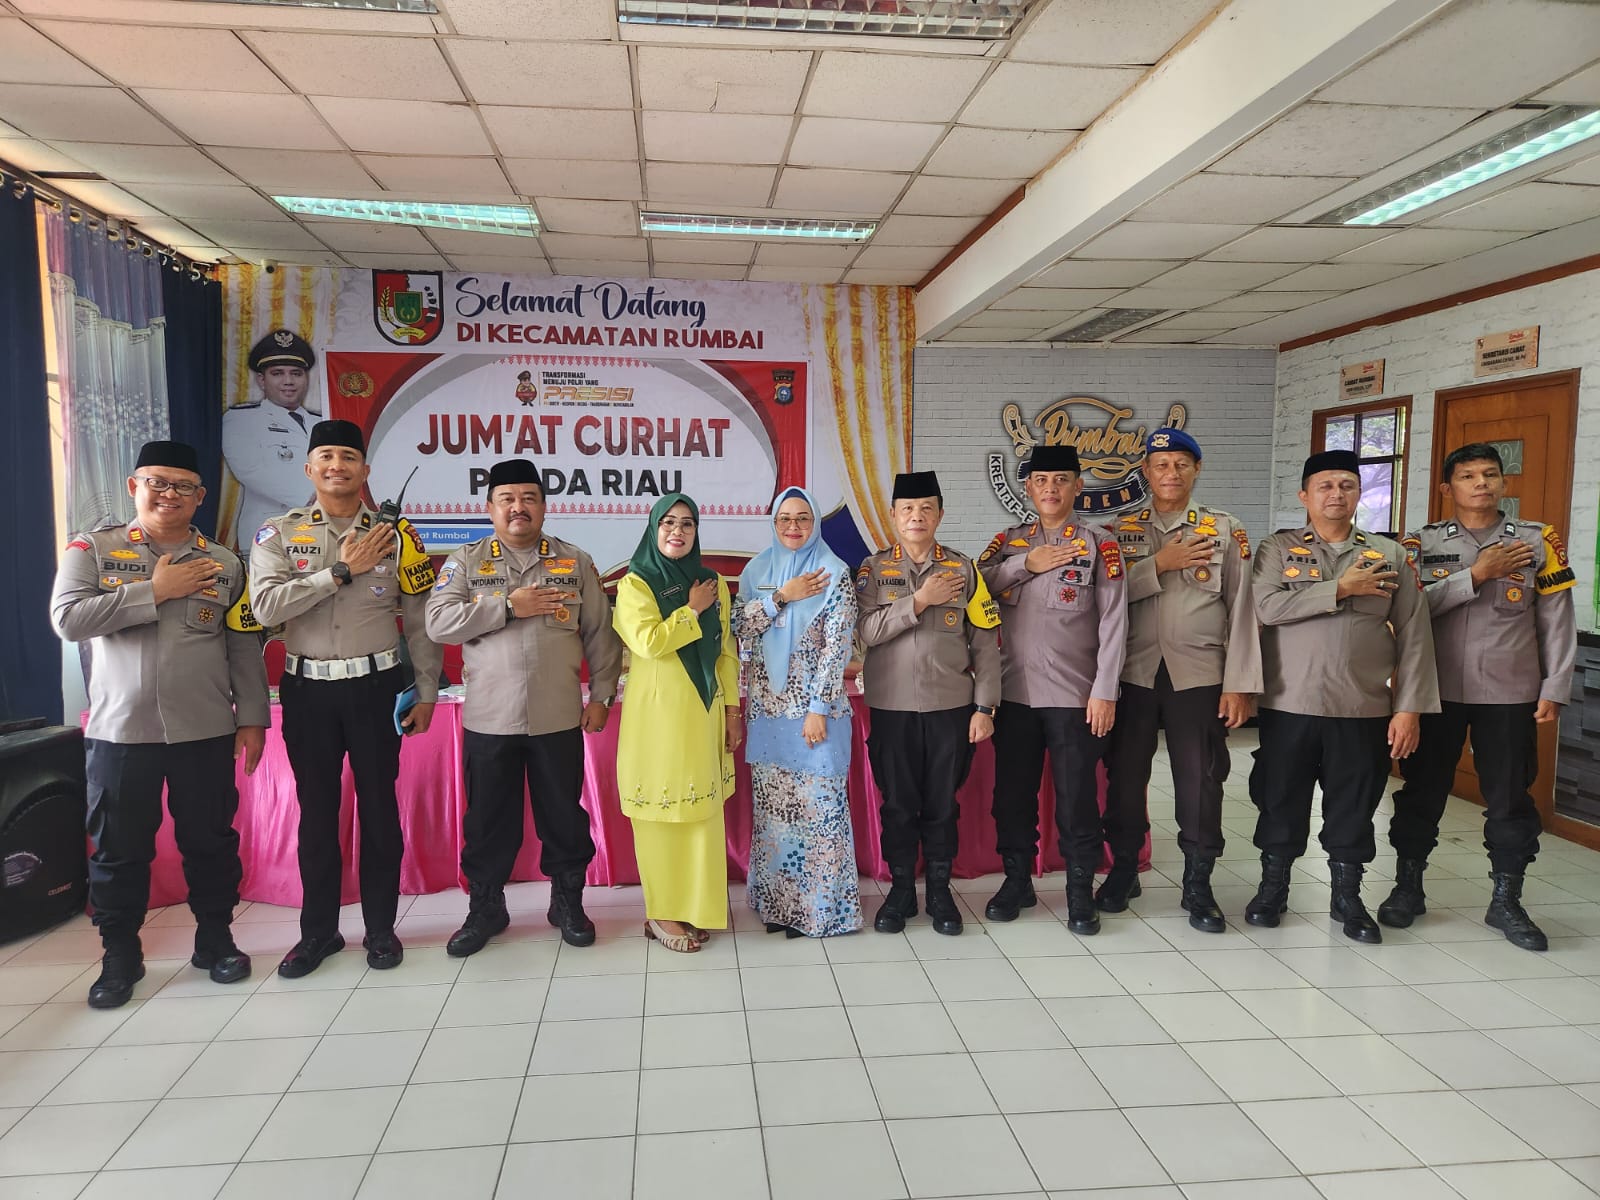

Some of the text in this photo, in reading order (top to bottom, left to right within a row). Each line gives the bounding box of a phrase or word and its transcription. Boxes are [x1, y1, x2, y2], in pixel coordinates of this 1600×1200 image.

[456, 276, 706, 328] Selamat Datang
[457, 322, 763, 349] DI KECAMATAN RUMBAI
[542, 371, 586, 379] TRANSFORMASI
[543, 378, 566, 386] MENUJU
[544, 386, 634, 402] PRESISI
[417, 413, 730, 458] JUM'AT CURHAT
[469, 467, 682, 497] PDA RIAU
[432, 531, 470, 539] Rumbai
[1118, 535, 1145, 543] LILIK
[286, 546, 321, 555] FAUZI
[1287, 555, 1317, 564] ARIS
[103, 561, 147, 573] BUDI
[471, 578, 505, 587] WIDIANTO
[545, 577, 578, 586] POLRI
